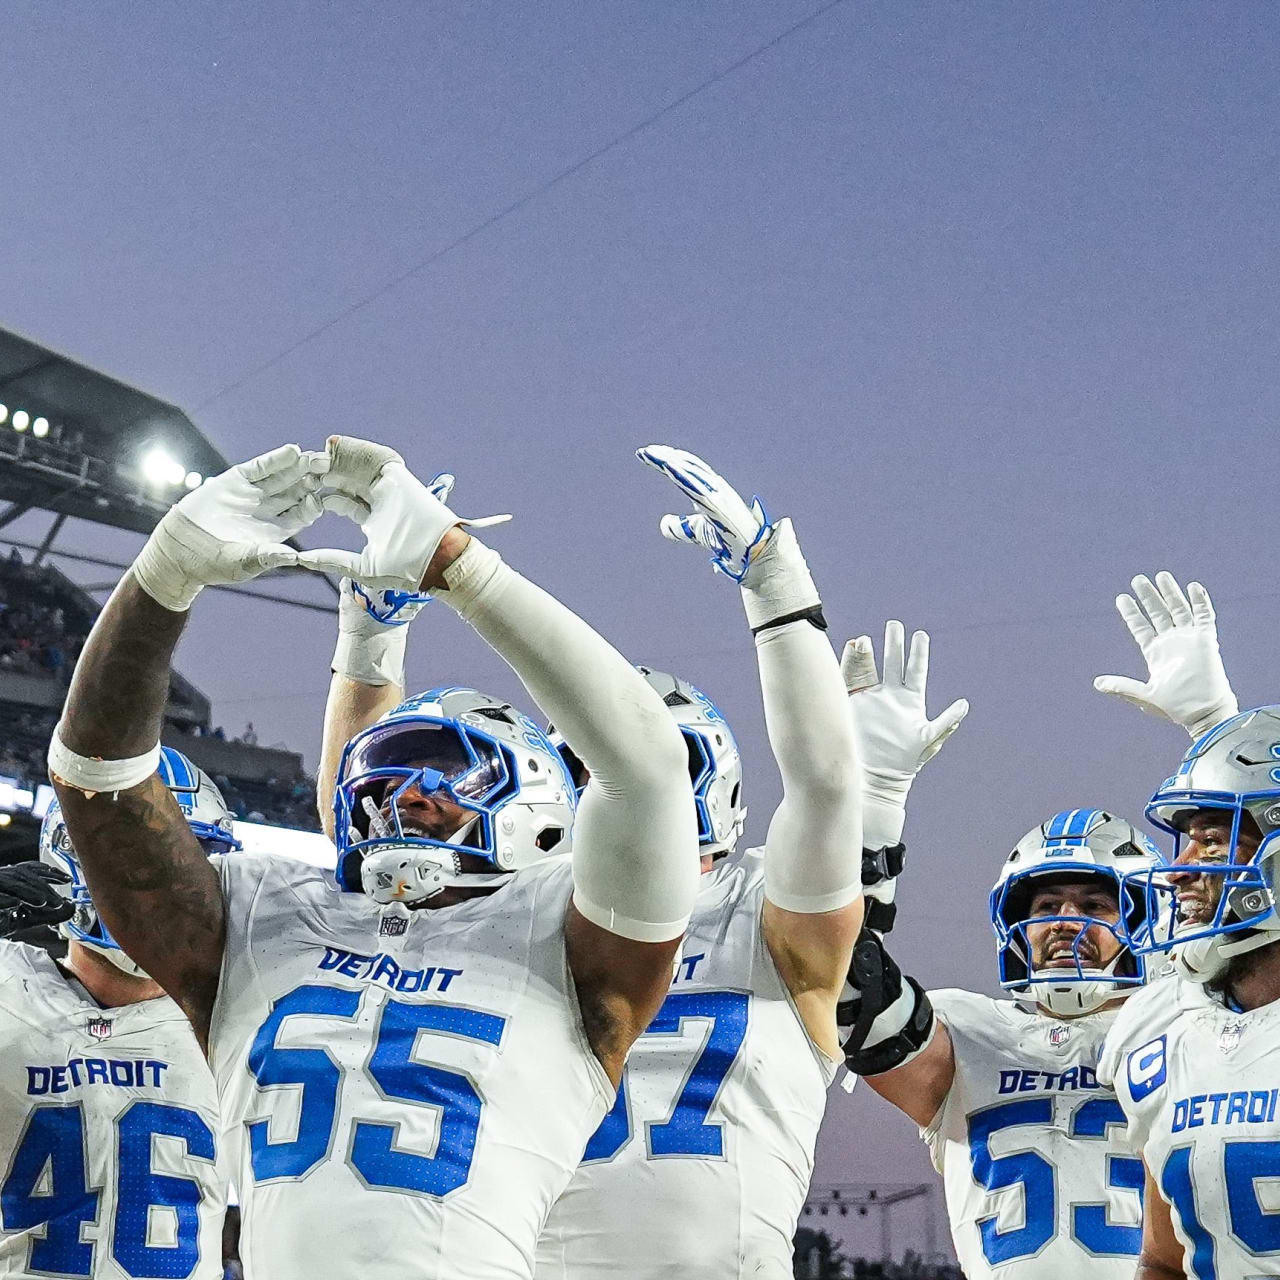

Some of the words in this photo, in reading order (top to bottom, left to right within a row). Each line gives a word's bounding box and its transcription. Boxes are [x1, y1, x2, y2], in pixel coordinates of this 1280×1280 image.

[318, 946, 464, 992] DETROIT
[25, 1058, 169, 1096] DETROIT
[998, 1064, 1102, 1095] DETRO
[1128, 1038, 1166, 1086] C
[243, 980, 513, 1203] 55
[966, 1095, 1146, 1271] 53
